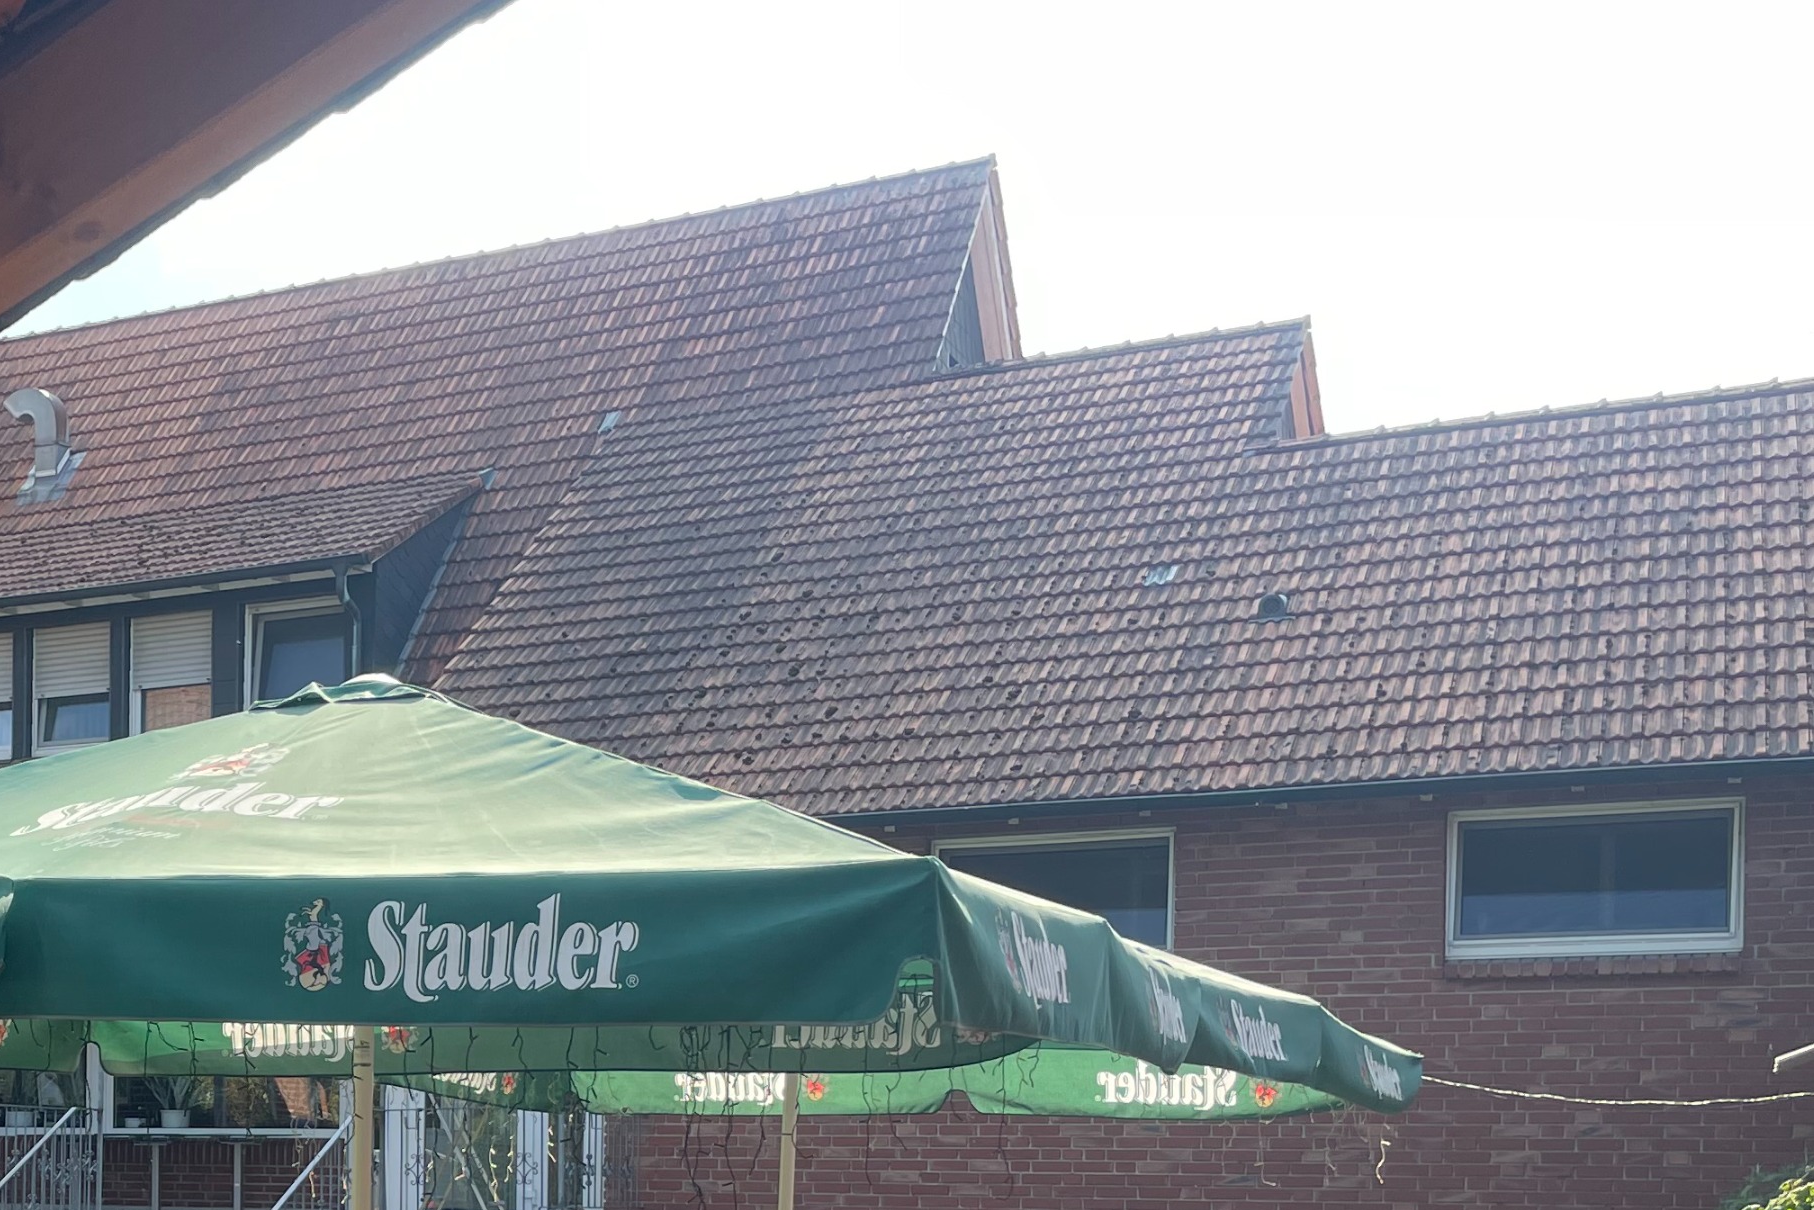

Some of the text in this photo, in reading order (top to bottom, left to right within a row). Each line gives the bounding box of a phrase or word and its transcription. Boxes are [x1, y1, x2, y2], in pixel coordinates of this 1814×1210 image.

[10, 782, 344, 837] Stauder
[363, 892, 640, 1003] Stauder
[1011, 910, 1071, 1010] Stauder
[1230, 999, 1288, 1063] Stauder
